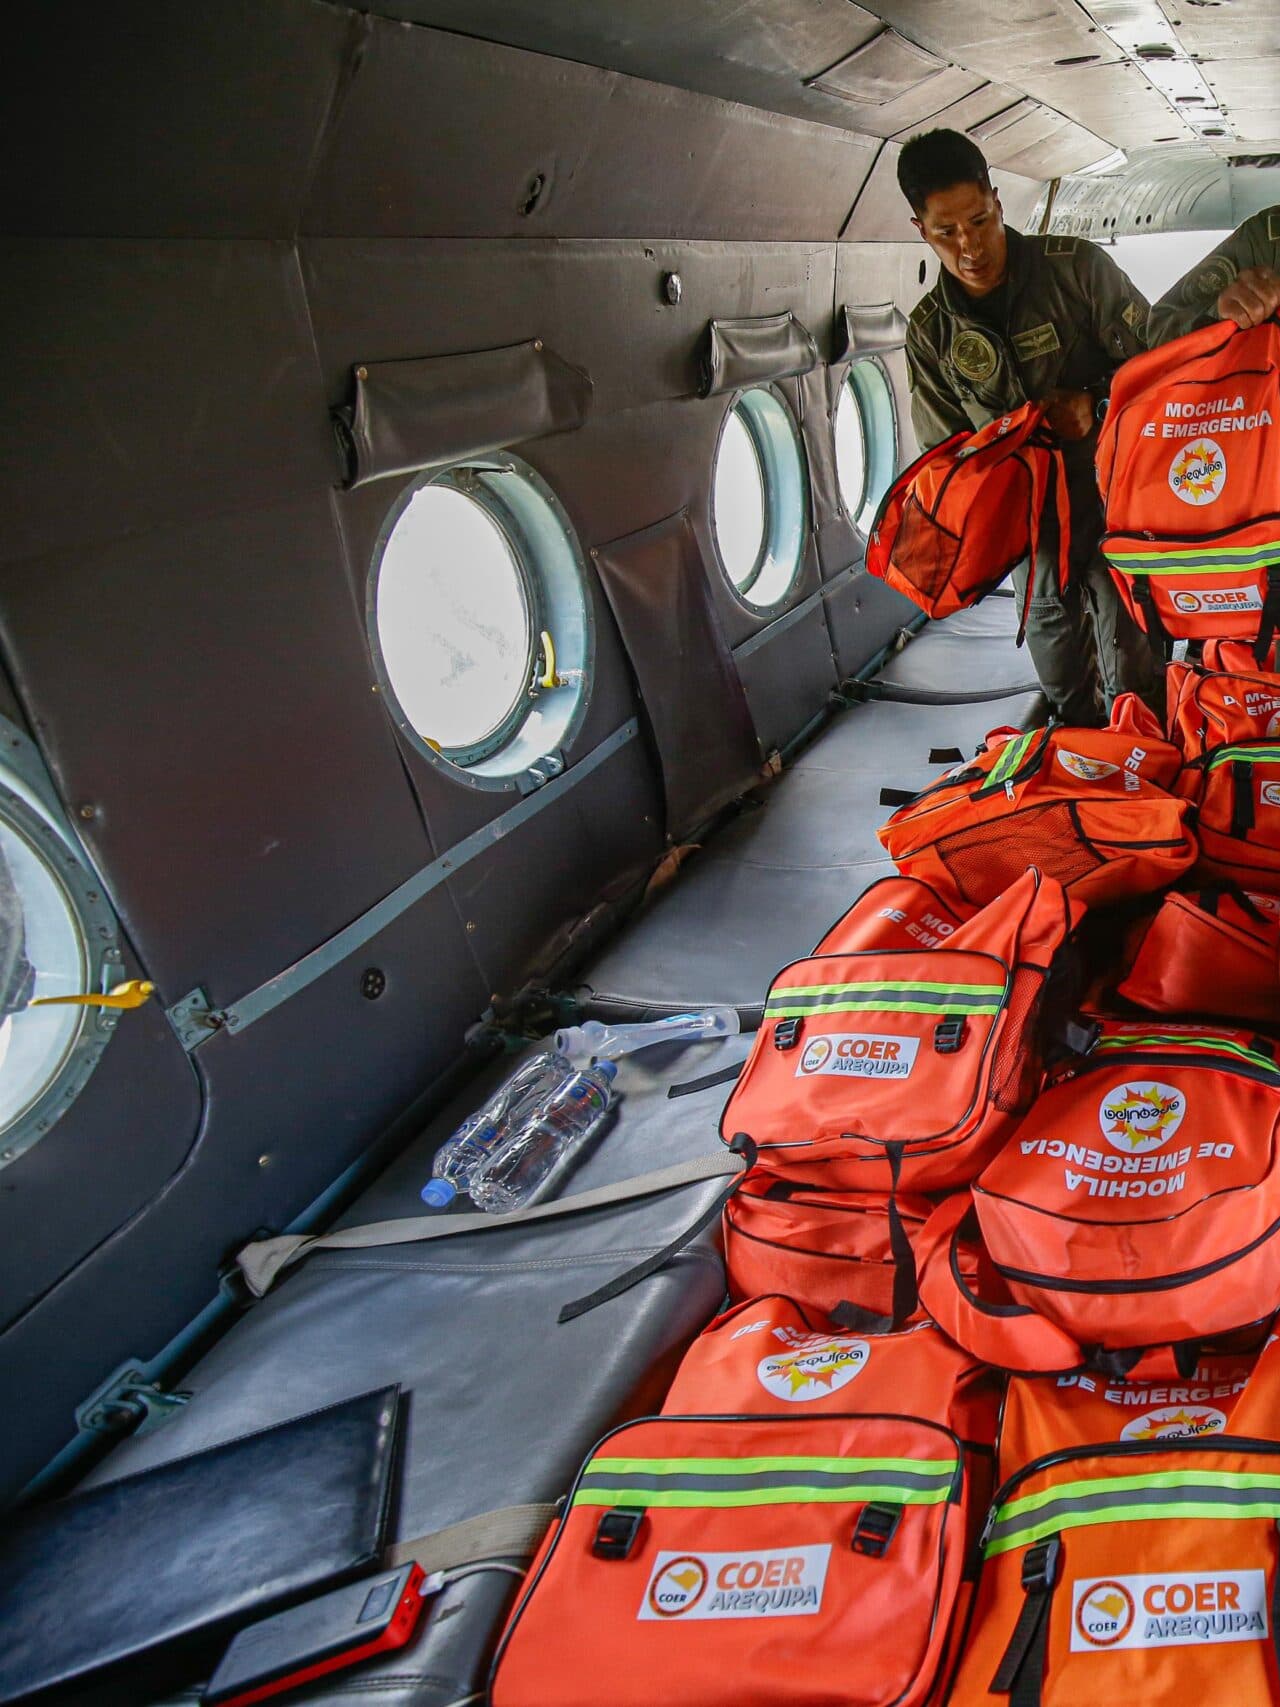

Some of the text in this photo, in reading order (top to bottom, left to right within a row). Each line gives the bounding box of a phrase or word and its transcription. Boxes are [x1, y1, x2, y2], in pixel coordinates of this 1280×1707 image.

[1165, 396, 1245, 418] MOCHILA
[1162, 409, 1273, 439] EMERGENCIA
[1201, 591, 1249, 604] COER
[1124, 747, 1147, 771] DE
[876, 907, 908, 923] DE
[837, 1039, 901, 1060] COER
[832, 1058, 910, 1076] AREQUIPA
[1020, 1139, 1234, 1174] DE EMERGENCIA
[1064, 1169, 1186, 1198] MOCHILA
[1056, 1376, 1097, 1392] DE
[1104, 1380, 1250, 1405] EMERGEN
[716, 1557, 805, 1591] COER
[658, 1592, 688, 1603] COER
[708, 1585, 818, 1613] AREQUIPA
[1143, 1581, 1241, 1615] COER
[1088, 1621, 1118, 1633] COER
[1143, 1610, 1266, 1641] AREQUIPA
